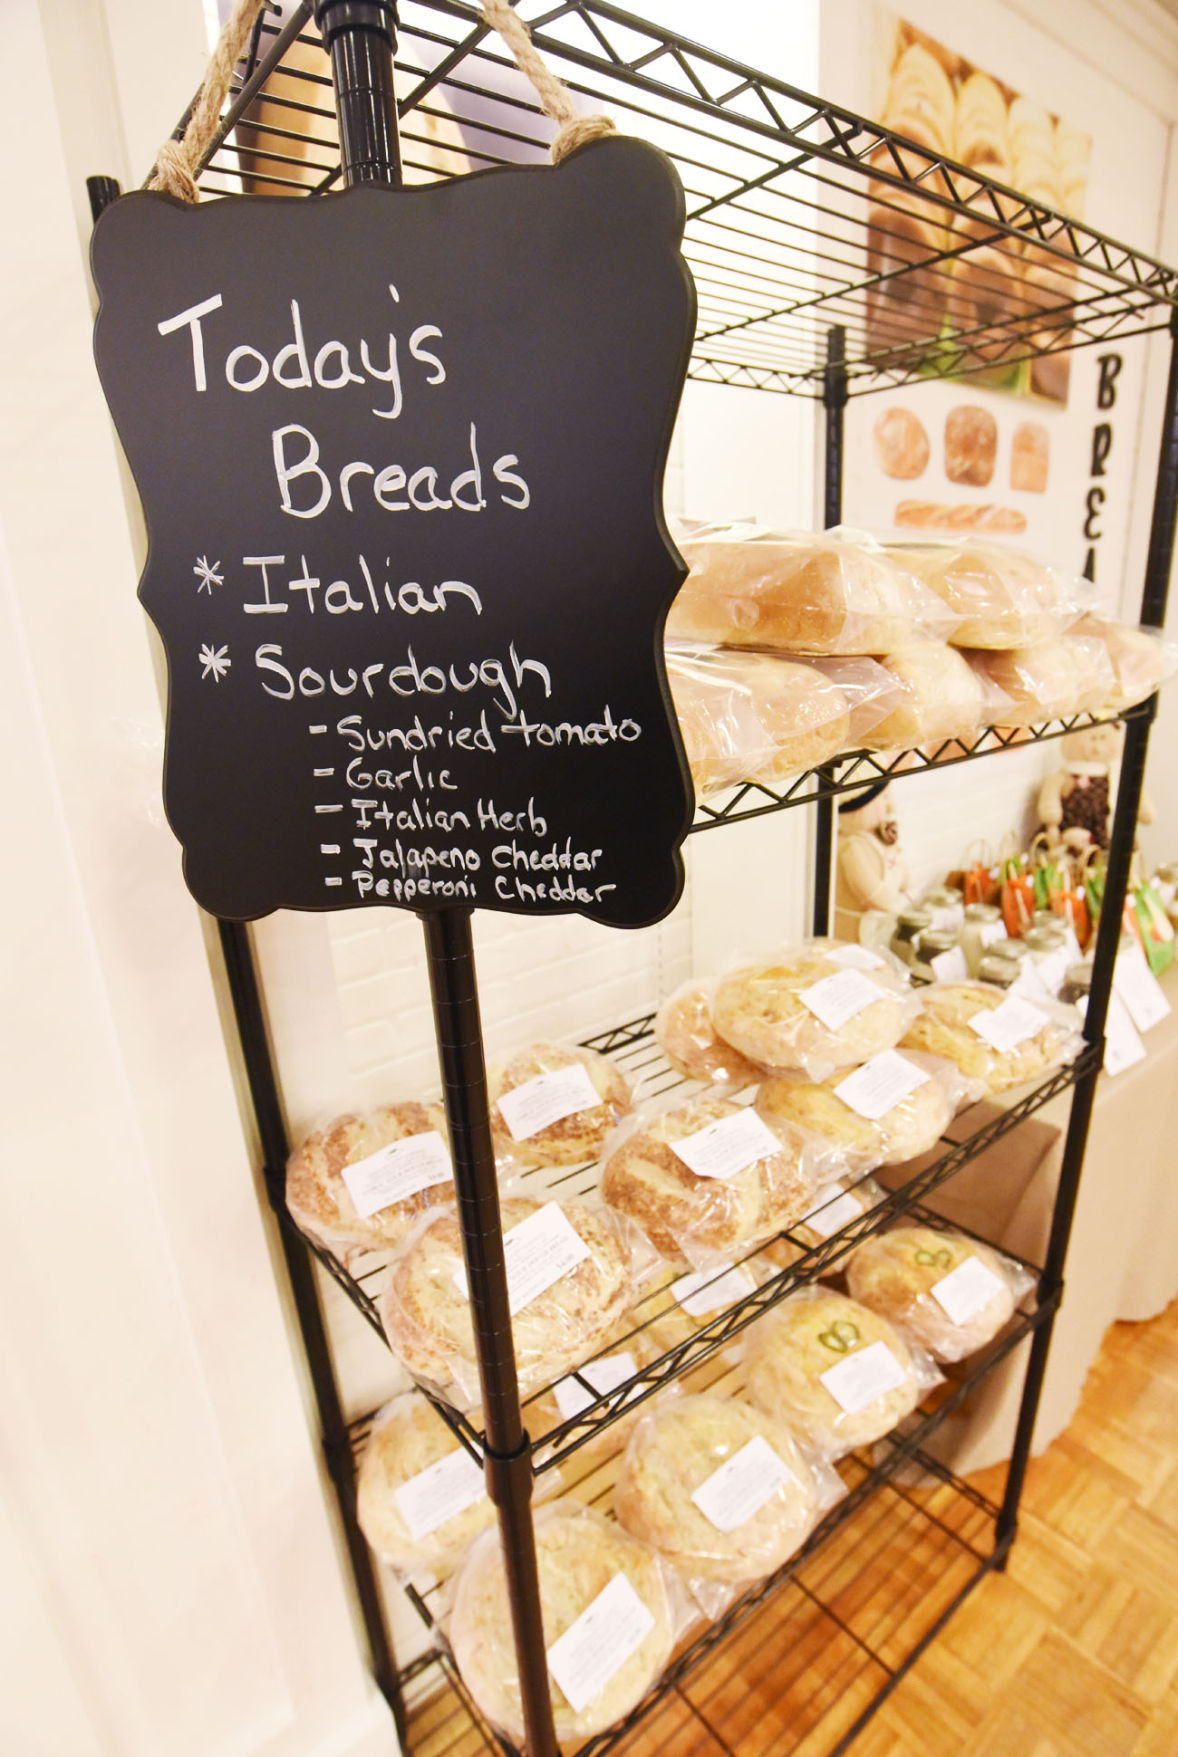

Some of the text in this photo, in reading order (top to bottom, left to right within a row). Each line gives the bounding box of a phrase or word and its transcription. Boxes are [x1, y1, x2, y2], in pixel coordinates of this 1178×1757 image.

[156, 283, 447, 420] Today's
[271, 417, 531, 519] Breads
[242, 554, 483, 616] Italian
[254, 641, 552, 721] Sourdough
[336, 709, 497, 753] Sundried
[500, 704, 642, 747] tomato
[345, 754, 458, 791] Garlic
[351, 797, 471, 832] Italian
[477, 796, 547, 837] Herb
[352, 837, 481, 878] Jalapeno
[351, 870, 477, 902] Pepperoni
